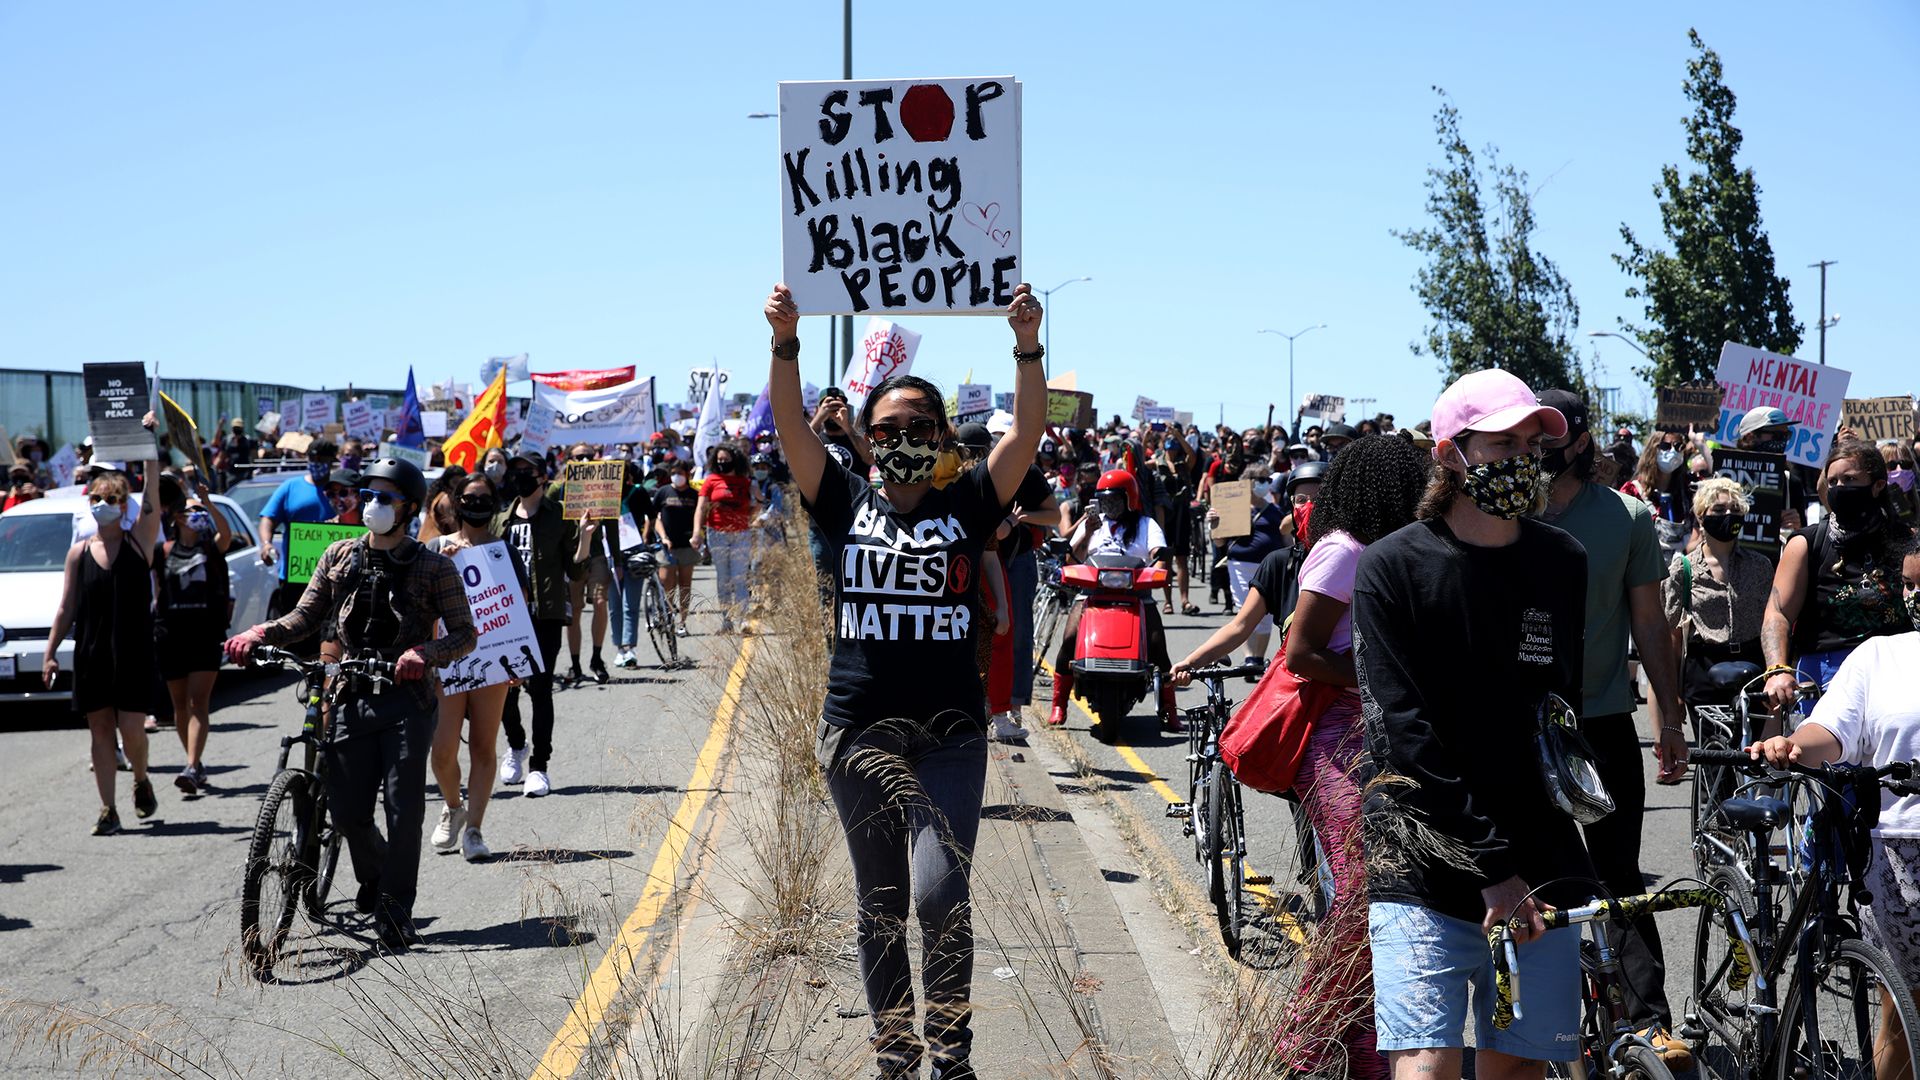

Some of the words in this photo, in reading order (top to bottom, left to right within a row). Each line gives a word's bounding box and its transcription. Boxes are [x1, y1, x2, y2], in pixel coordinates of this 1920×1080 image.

[819, 81, 1005, 145] STOP
[784, 147, 962, 216] Killing
[808, 211, 965, 273] Black
[841, 256, 1018, 312] PEOPLE
[864, 329, 890, 351] BLACK
[891, 332, 907, 364] LIVES
[108, 379, 122, 388] NO
[848, 380, 875, 397] MAT
[1747, 358, 1818, 398] MENTAL
[99, 388, 135, 397] JUSTICE
[968, 390, 981, 400] NO
[105, 409, 134, 418] PEACE
[112, 401, 125, 410] NO
[1845, 402, 1880, 414] BLACK
[1883, 400, 1913, 412] LIVES
[1849, 414, 1916, 440] MATTER
[1785, 425, 1824, 463] OPS
[567, 464, 597, 481] DEFUND
[597, 462, 622, 481] POLICE
[1721, 458, 1732, 469] AN
[1735, 460, 1763, 471] INJURY
[1766, 462, 1775, 472] TO
[848, 502, 968, 551] BLACK
[1744, 513, 1760, 523] URY
[1762, 514, 1772, 524] TO
[293, 528, 322, 541] TEACH
[1737, 524, 1775, 543] LL
[463, 564, 481, 588] O
[843, 547, 946, 594] LIVES
[467, 583, 507, 606] ization
[475, 602, 500, 620] Port
[501, 594, 514, 609] Of
[476, 613, 511, 637] LAND!
[841, 602, 970, 641] MATTER
